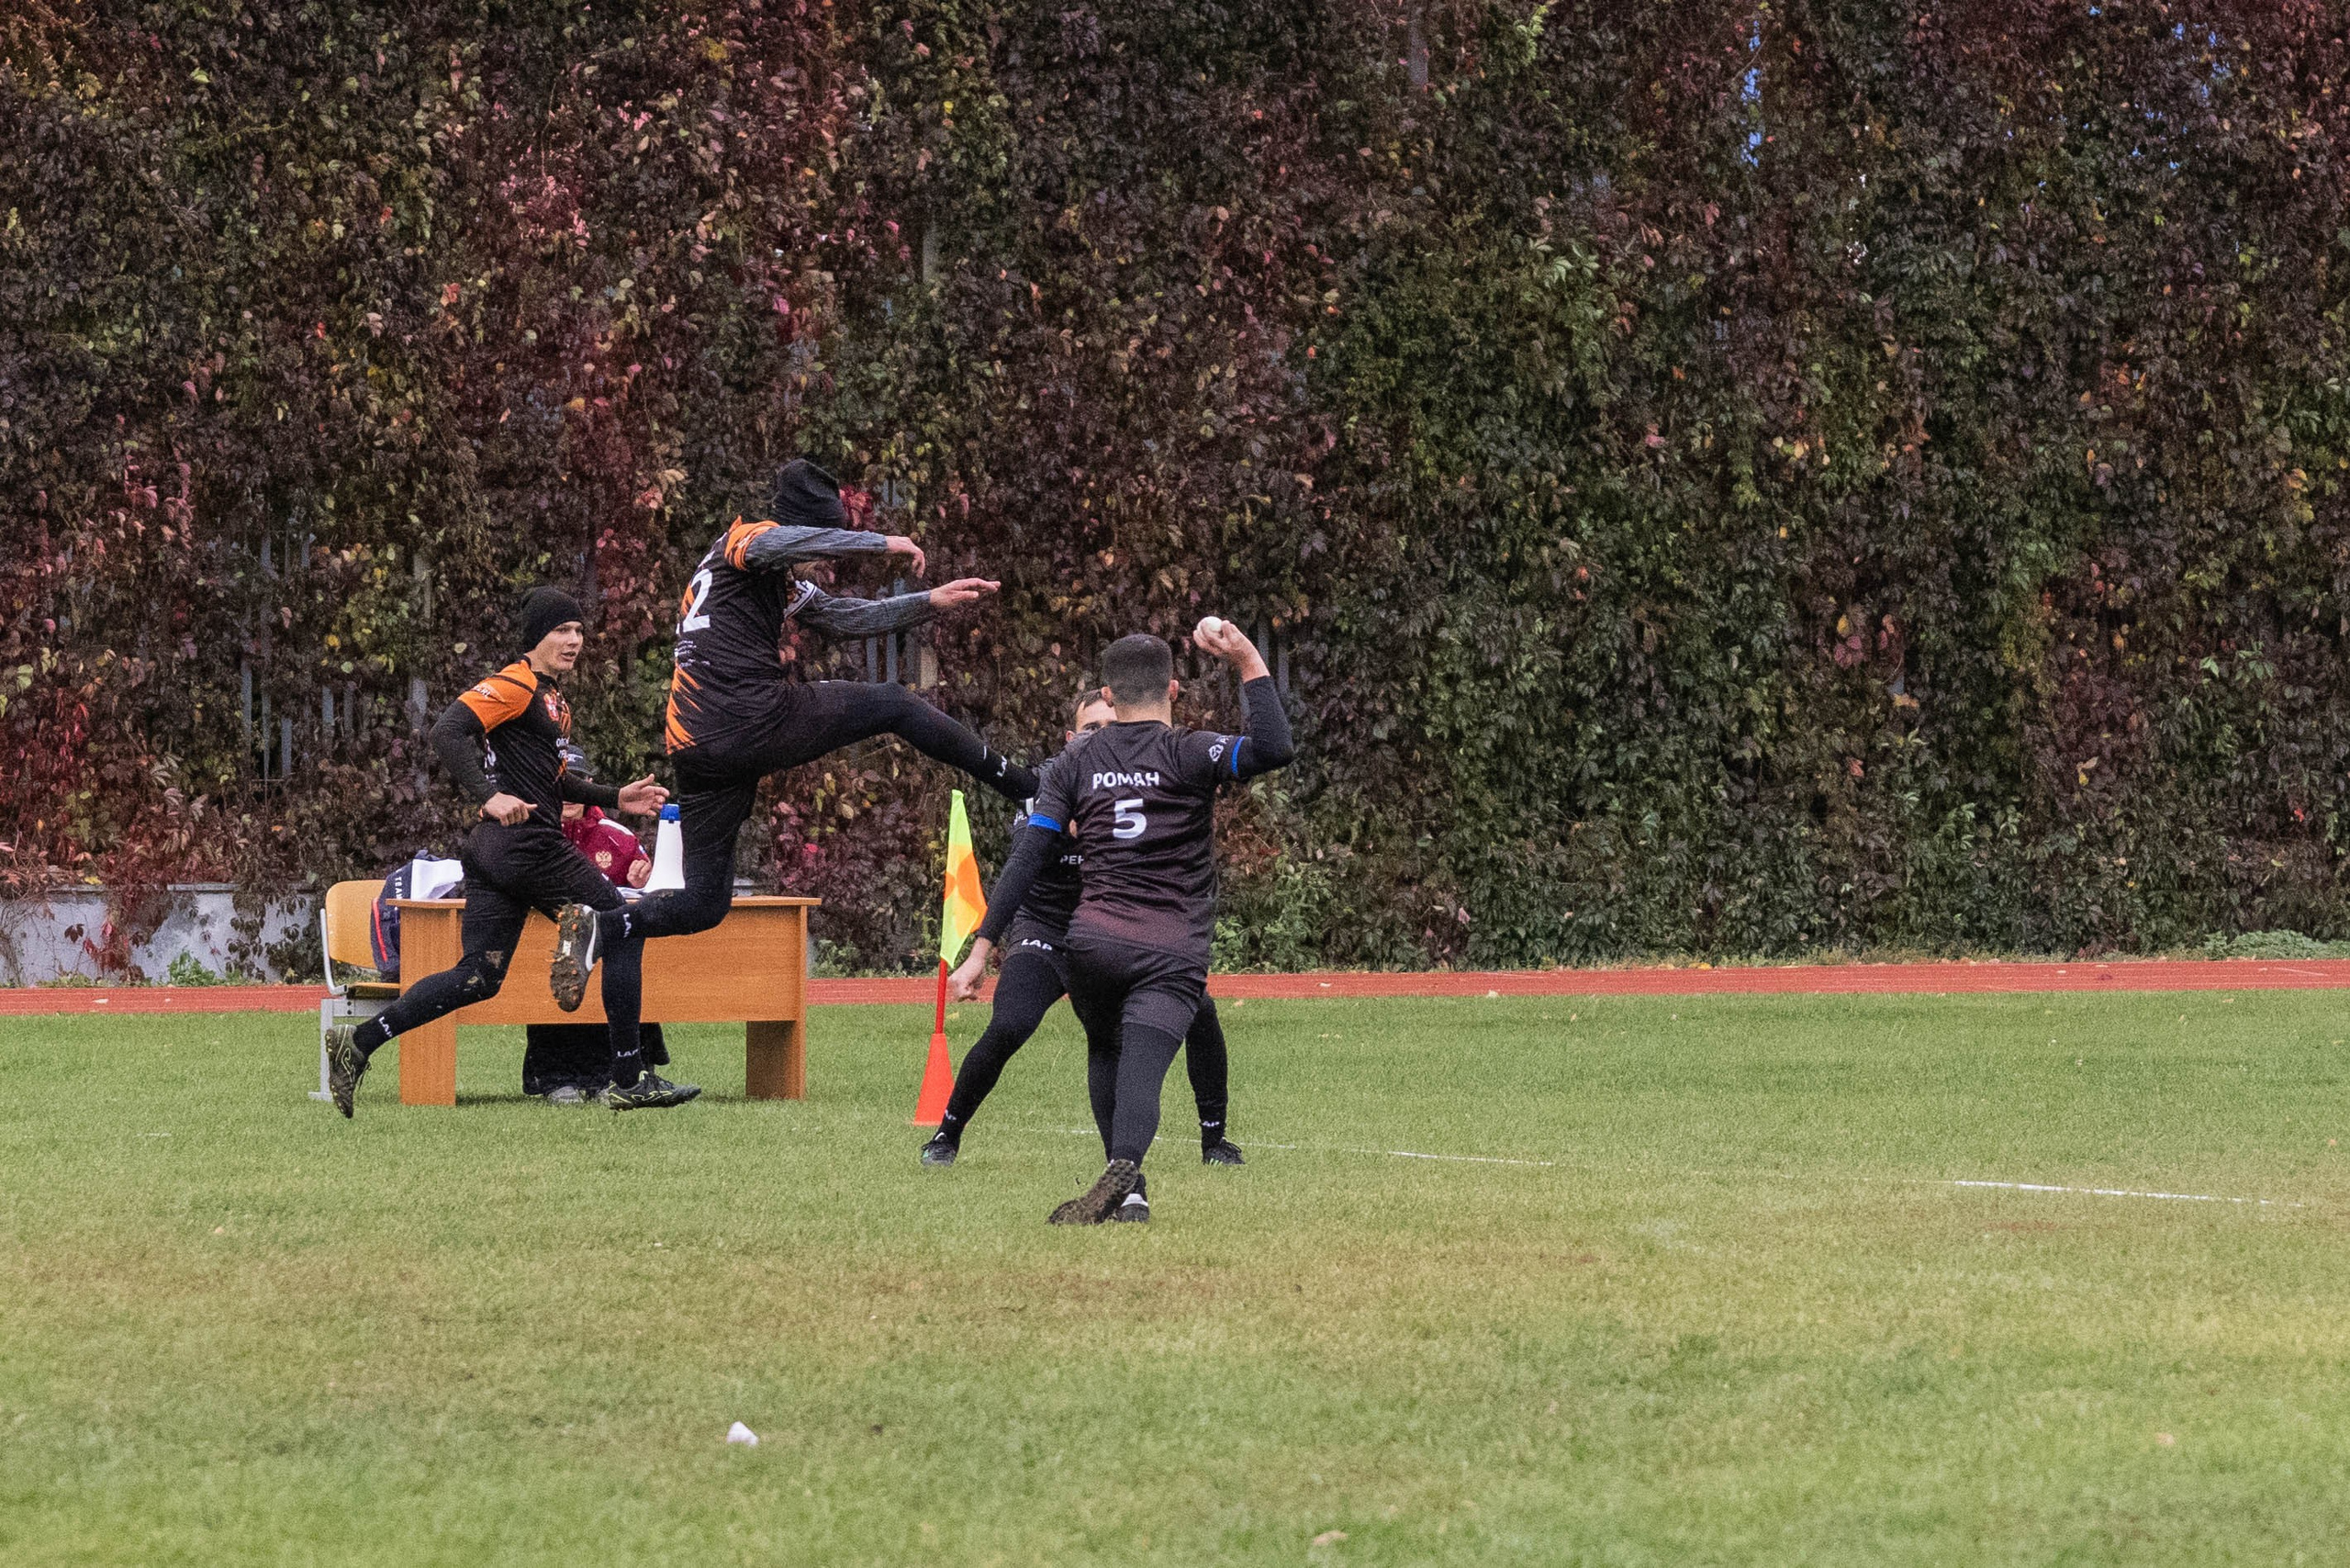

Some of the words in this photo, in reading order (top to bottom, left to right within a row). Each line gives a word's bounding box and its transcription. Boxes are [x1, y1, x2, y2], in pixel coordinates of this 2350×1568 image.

[1092, 771, 1160, 790] РОМАН
[1113, 798, 1147, 839] 5
[1021, 938, 1053, 951] LAP
